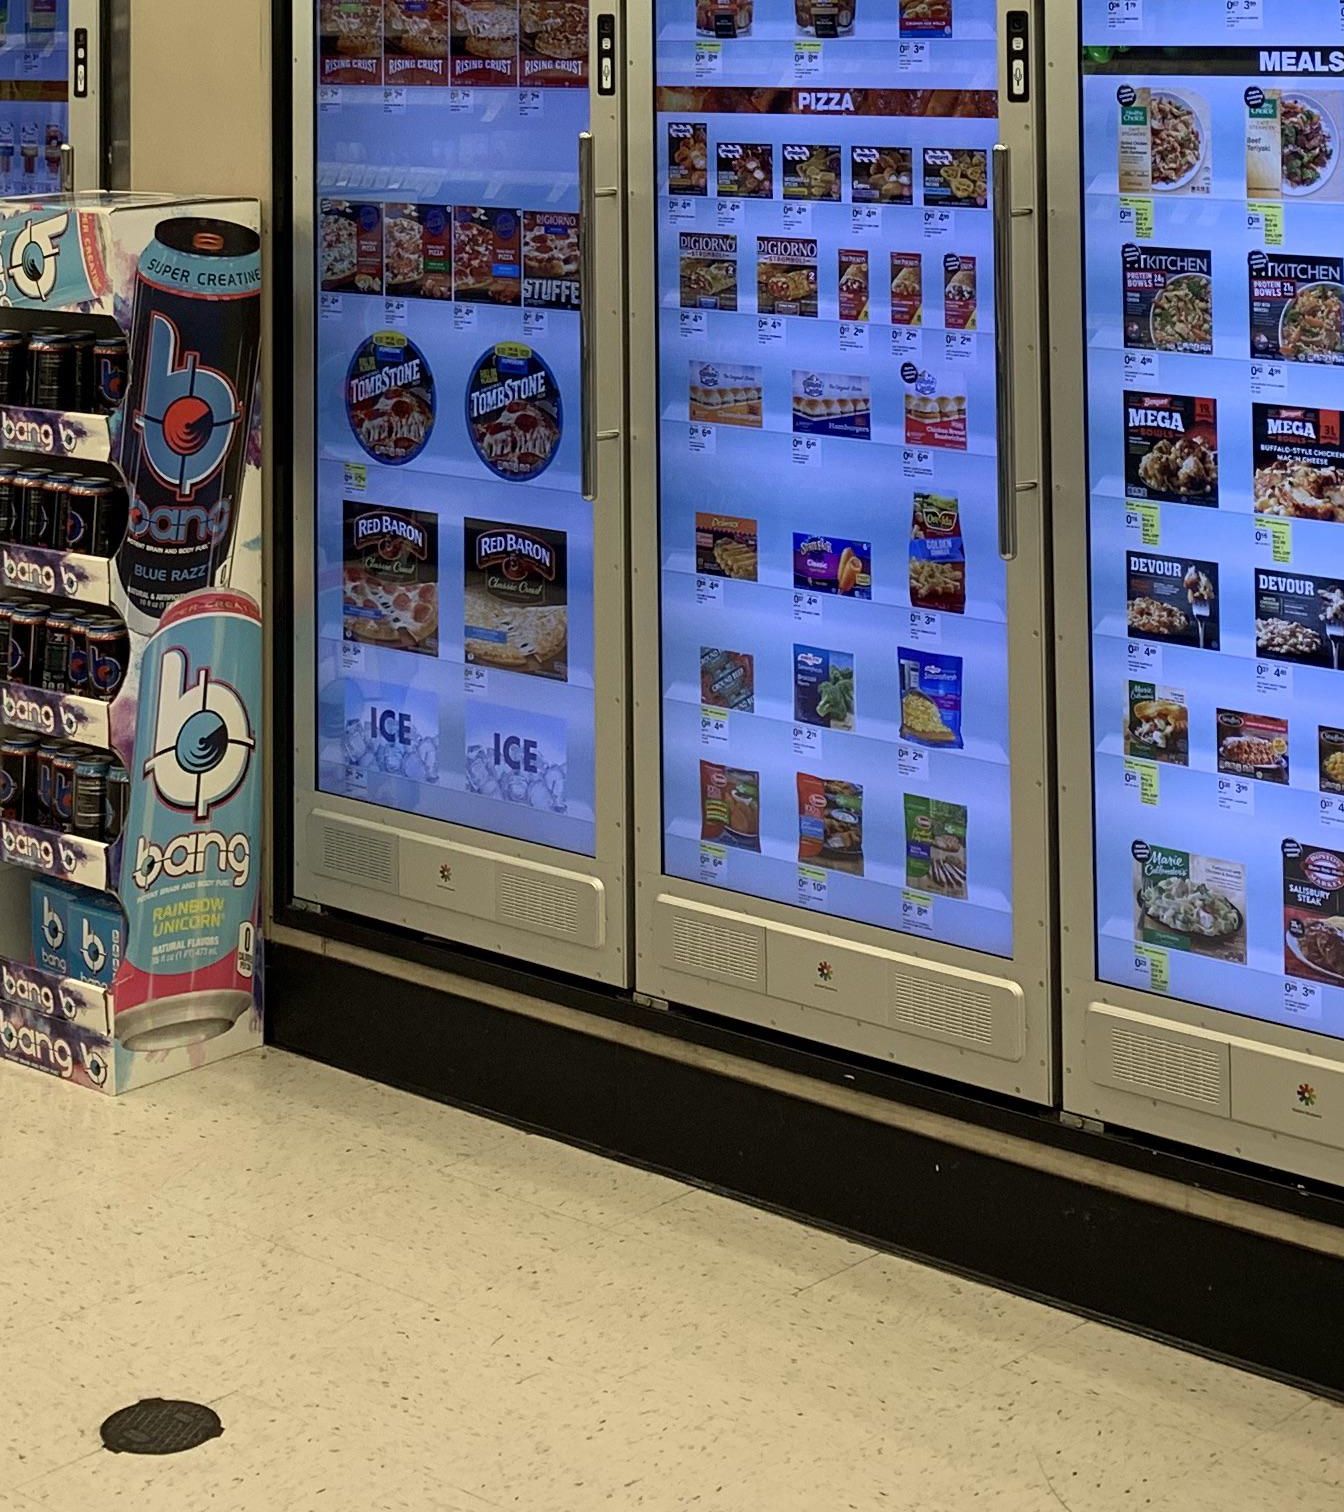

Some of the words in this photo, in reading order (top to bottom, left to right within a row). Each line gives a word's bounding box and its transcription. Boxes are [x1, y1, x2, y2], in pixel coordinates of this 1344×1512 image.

[325, 59, 352, 73] RISING
[353, 59, 376, 74] CRUST
[389, 59, 416, 74] RISING
[418, 59, 442, 74] CRUST
[456, 59, 483, 74] RISING
[485, 60, 511, 75] CRUST
[525, 60, 554, 75] RISING
[556, 60, 582, 76] CRUST
[798, 92, 855, 112] PIZZA
[680, 237, 735, 252] DIGIORNO
[757, 240, 816, 258] DIGIORNO
[149, 258, 190, 287] SUPER
[197, 266, 261, 287] CREATINE
[1127, 279, 1152, 287] BOWLS
[1254, 281, 1281, 289] PROTEIN
[1254, 288, 1281, 296] BOWLS
[351, 359, 420, 404] TOMBSTONE
[471, 371, 545, 417] TOMBSTONE
[2, 412, 53, 446] bang
[829, 422, 869, 434] Hamburgers
[1128, 408, 1185, 432] MEGA
[1267, 419, 1316, 438] MEGA
[1260, 444, 1312, 456] BUFFALO-STYLE
[1314, 449, 1344, 459] CHICKEN
[1300, 456, 1328, 465] CHEESE
[128, 496, 231, 544] bang
[359, 519, 380, 537] RED
[382, 516, 422, 547] BARON
[481, 537, 505, 556] RED
[506, 534, 550, 567] BARON
[4, 550, 56, 593] bang
[135, 564, 166, 581] BLUE
[171, 564, 208, 581] RAZZ
[1130, 556, 1182, 578] DEVOUR
[1259, 574, 1315, 597] DEVOUR
[1, 690, 54, 733] bang
[370, 707, 412, 747] ICE
[493, 732, 538, 774] ICE
[2, 826, 54, 869] bang
[133, 831, 251, 889] bang
[1150, 851, 1184, 867] Marie
[1309, 851, 1342, 868] BOSTON
[1289, 883, 1331, 899] SALISBURY
[1310, 875, 1343, 889] MARKET
[1297, 893, 1322, 906] STEAK
[153, 898, 224, 921] RAINBOW
[153, 913, 220, 937] UNICORN
[153, 940, 185, 955] NATURAL
[187, 936, 219, 947] FLAVORS
[1, 967, 54, 1015] bang
